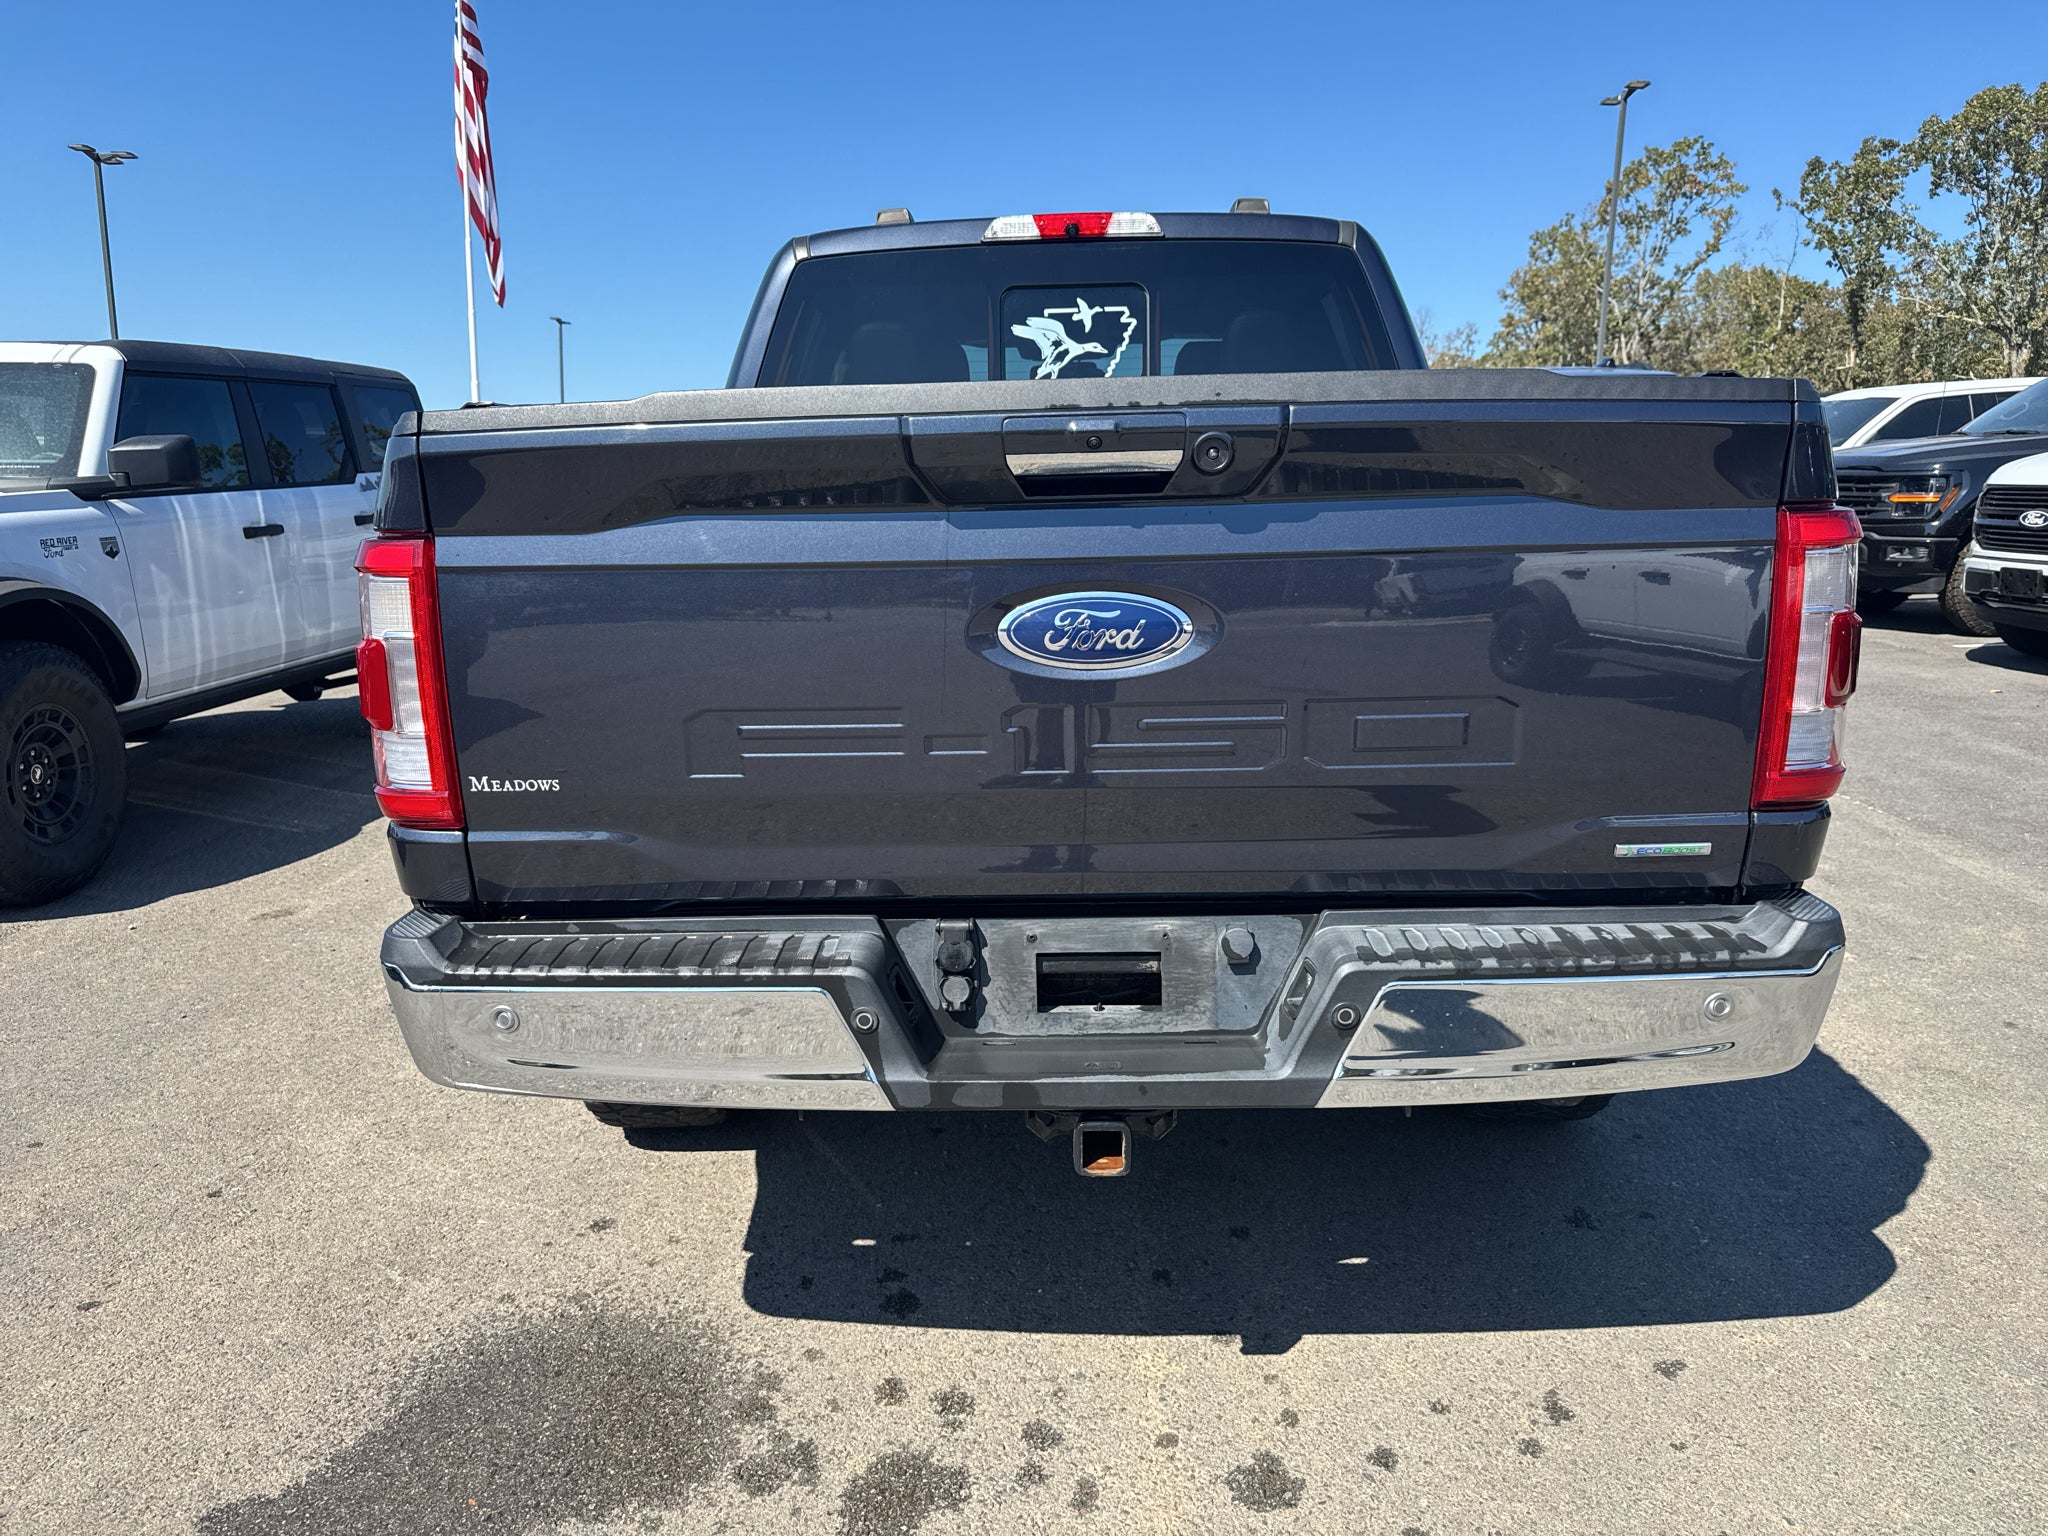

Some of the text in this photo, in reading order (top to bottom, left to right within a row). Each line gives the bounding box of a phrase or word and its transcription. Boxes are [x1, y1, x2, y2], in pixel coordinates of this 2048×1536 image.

[2025, 512, 2045, 524] Ford
[56, 535, 78, 546] RIVER
[43, 548, 64, 559] Ford
[1043, 608, 1147, 651] Ford
[683, 695, 1521, 778] F-150
